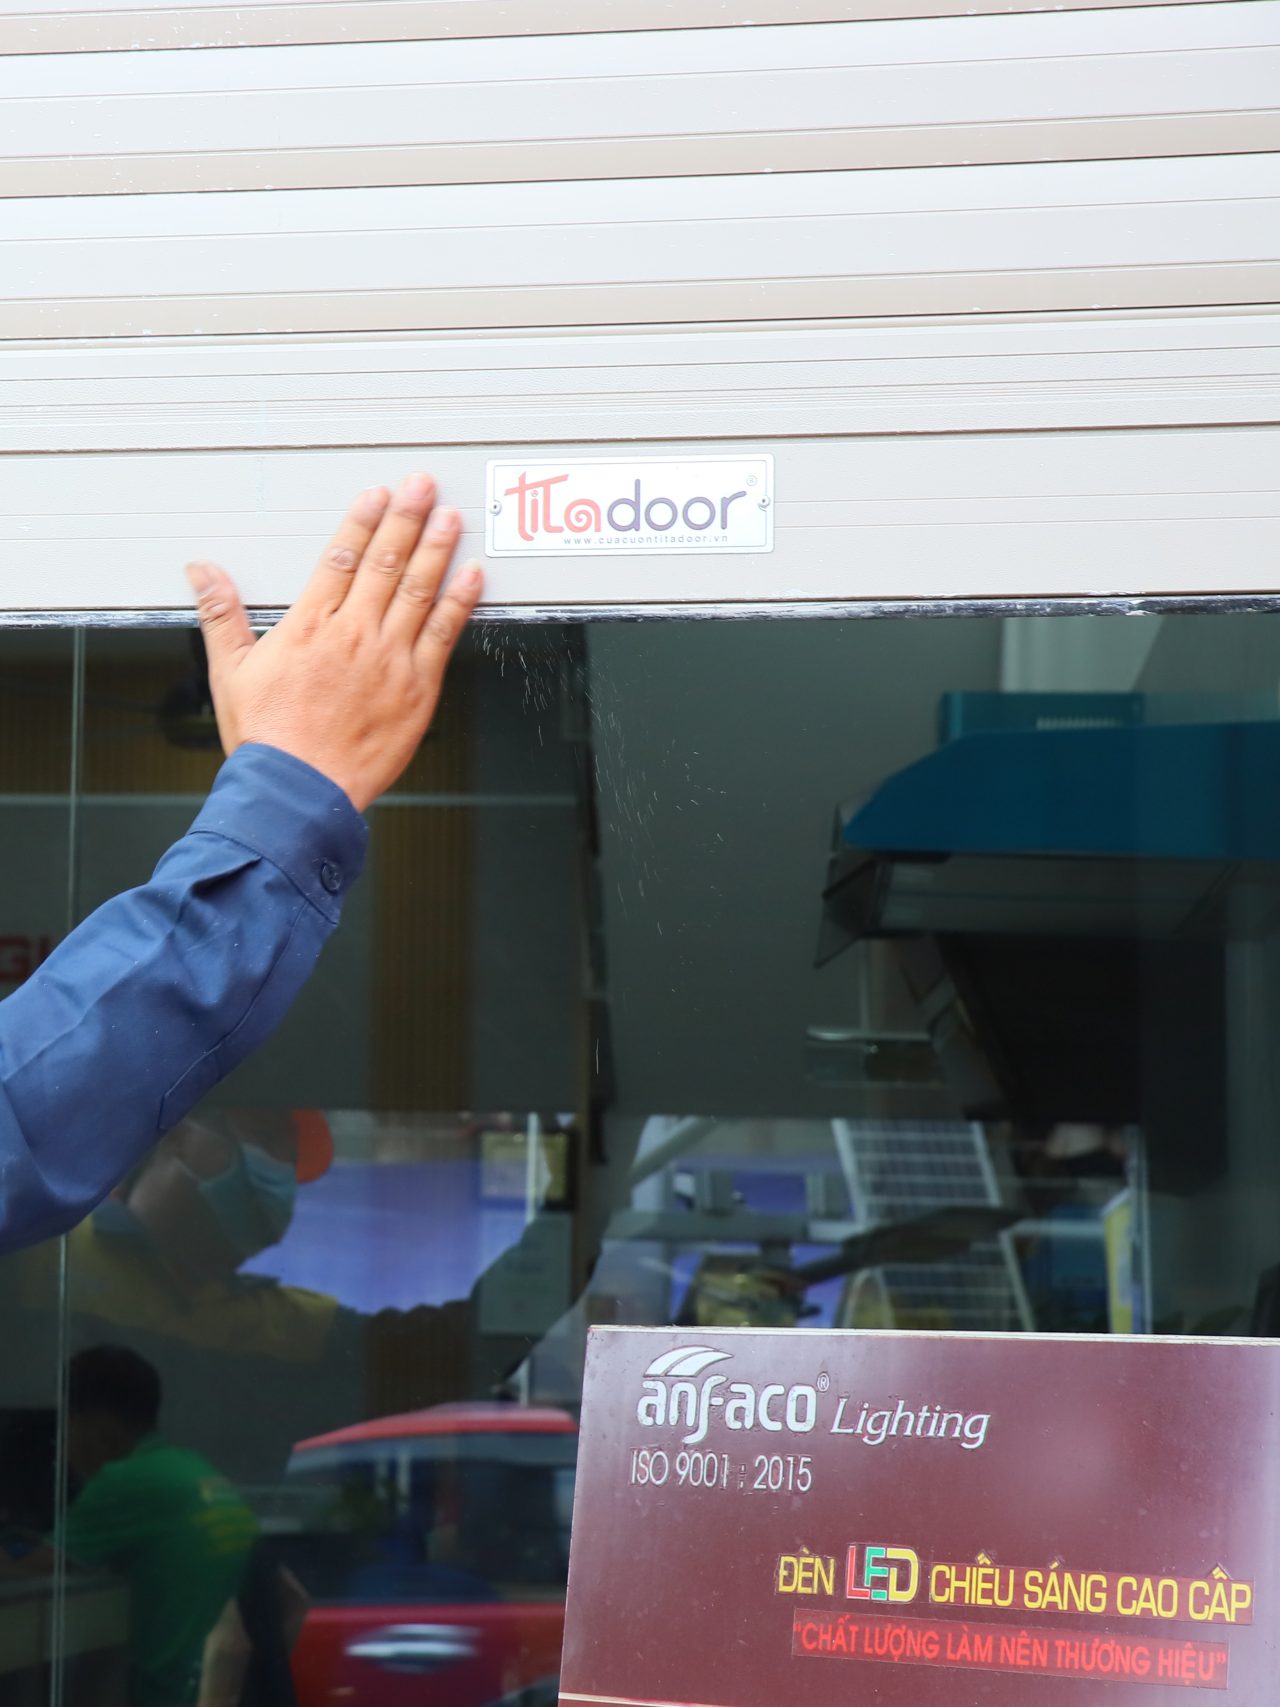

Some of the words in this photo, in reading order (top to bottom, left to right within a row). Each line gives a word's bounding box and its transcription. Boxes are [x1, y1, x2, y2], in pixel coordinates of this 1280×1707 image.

[563, 534, 729, 545] www.cuacuontitadoor.vn
[636, 1375, 818, 1444] anfaco
[830, 1397, 992, 1449] Lighting
[630, 1450, 669, 1487] ISO
[675, 1452, 729, 1489] 9001
[753, 1455, 813, 1492] 2015
[778, 1546, 835, 1595] ĐÈN
[846, 1545, 919, 1603] LED
[1023, 1560, 1107, 1613] SÁNG
[1116, 1576, 1179, 1618] CAO
[864, 1622, 940, 1663] LƯỢNG
[946, 1624, 993, 1664] LÀM
[999, 1630, 1049, 1668] NÊN
[1055, 1637, 1151, 1676] THƯƠNG
